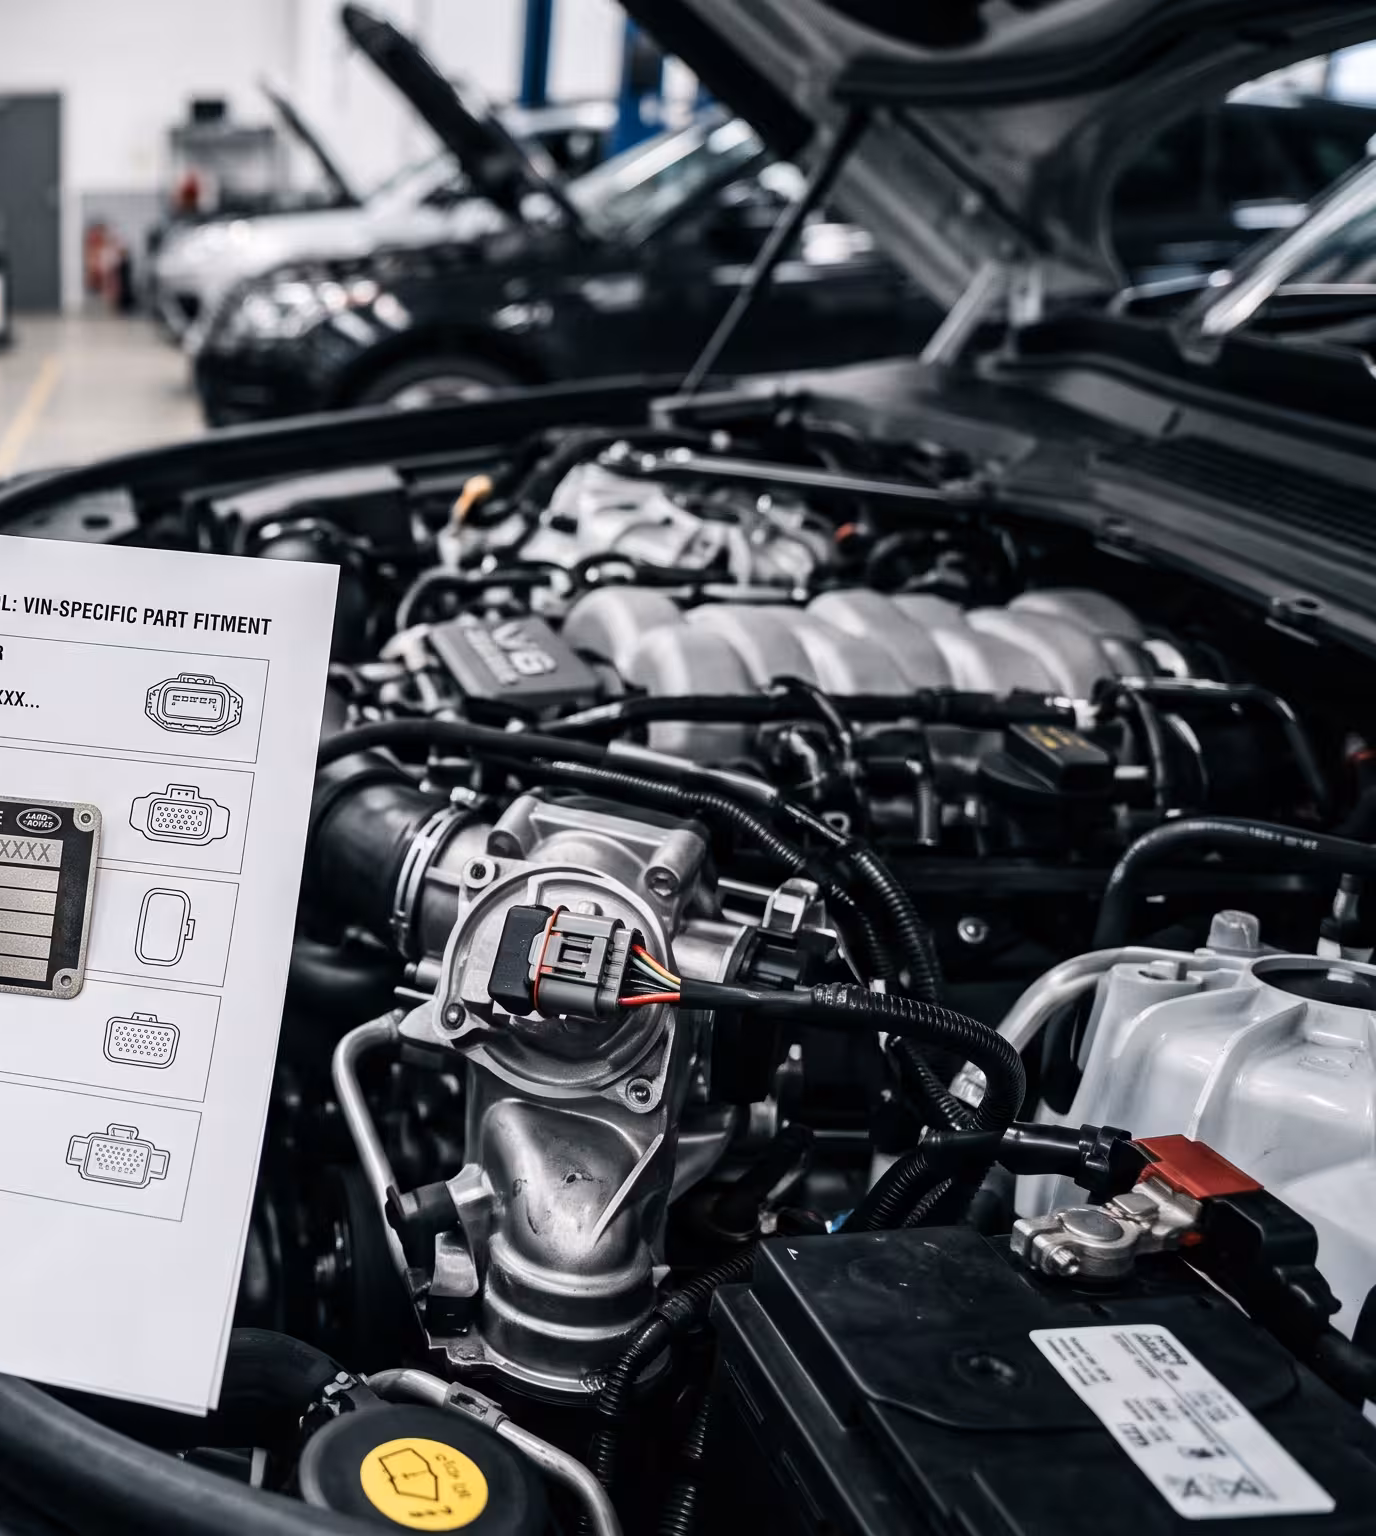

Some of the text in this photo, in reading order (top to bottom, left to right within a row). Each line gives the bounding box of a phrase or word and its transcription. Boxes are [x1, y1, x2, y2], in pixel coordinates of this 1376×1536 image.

[23, 596, 138, 624] VIN-SPECIFIC
[142, 607, 189, 629] PART
[193, 612, 273, 636] FITMENT
